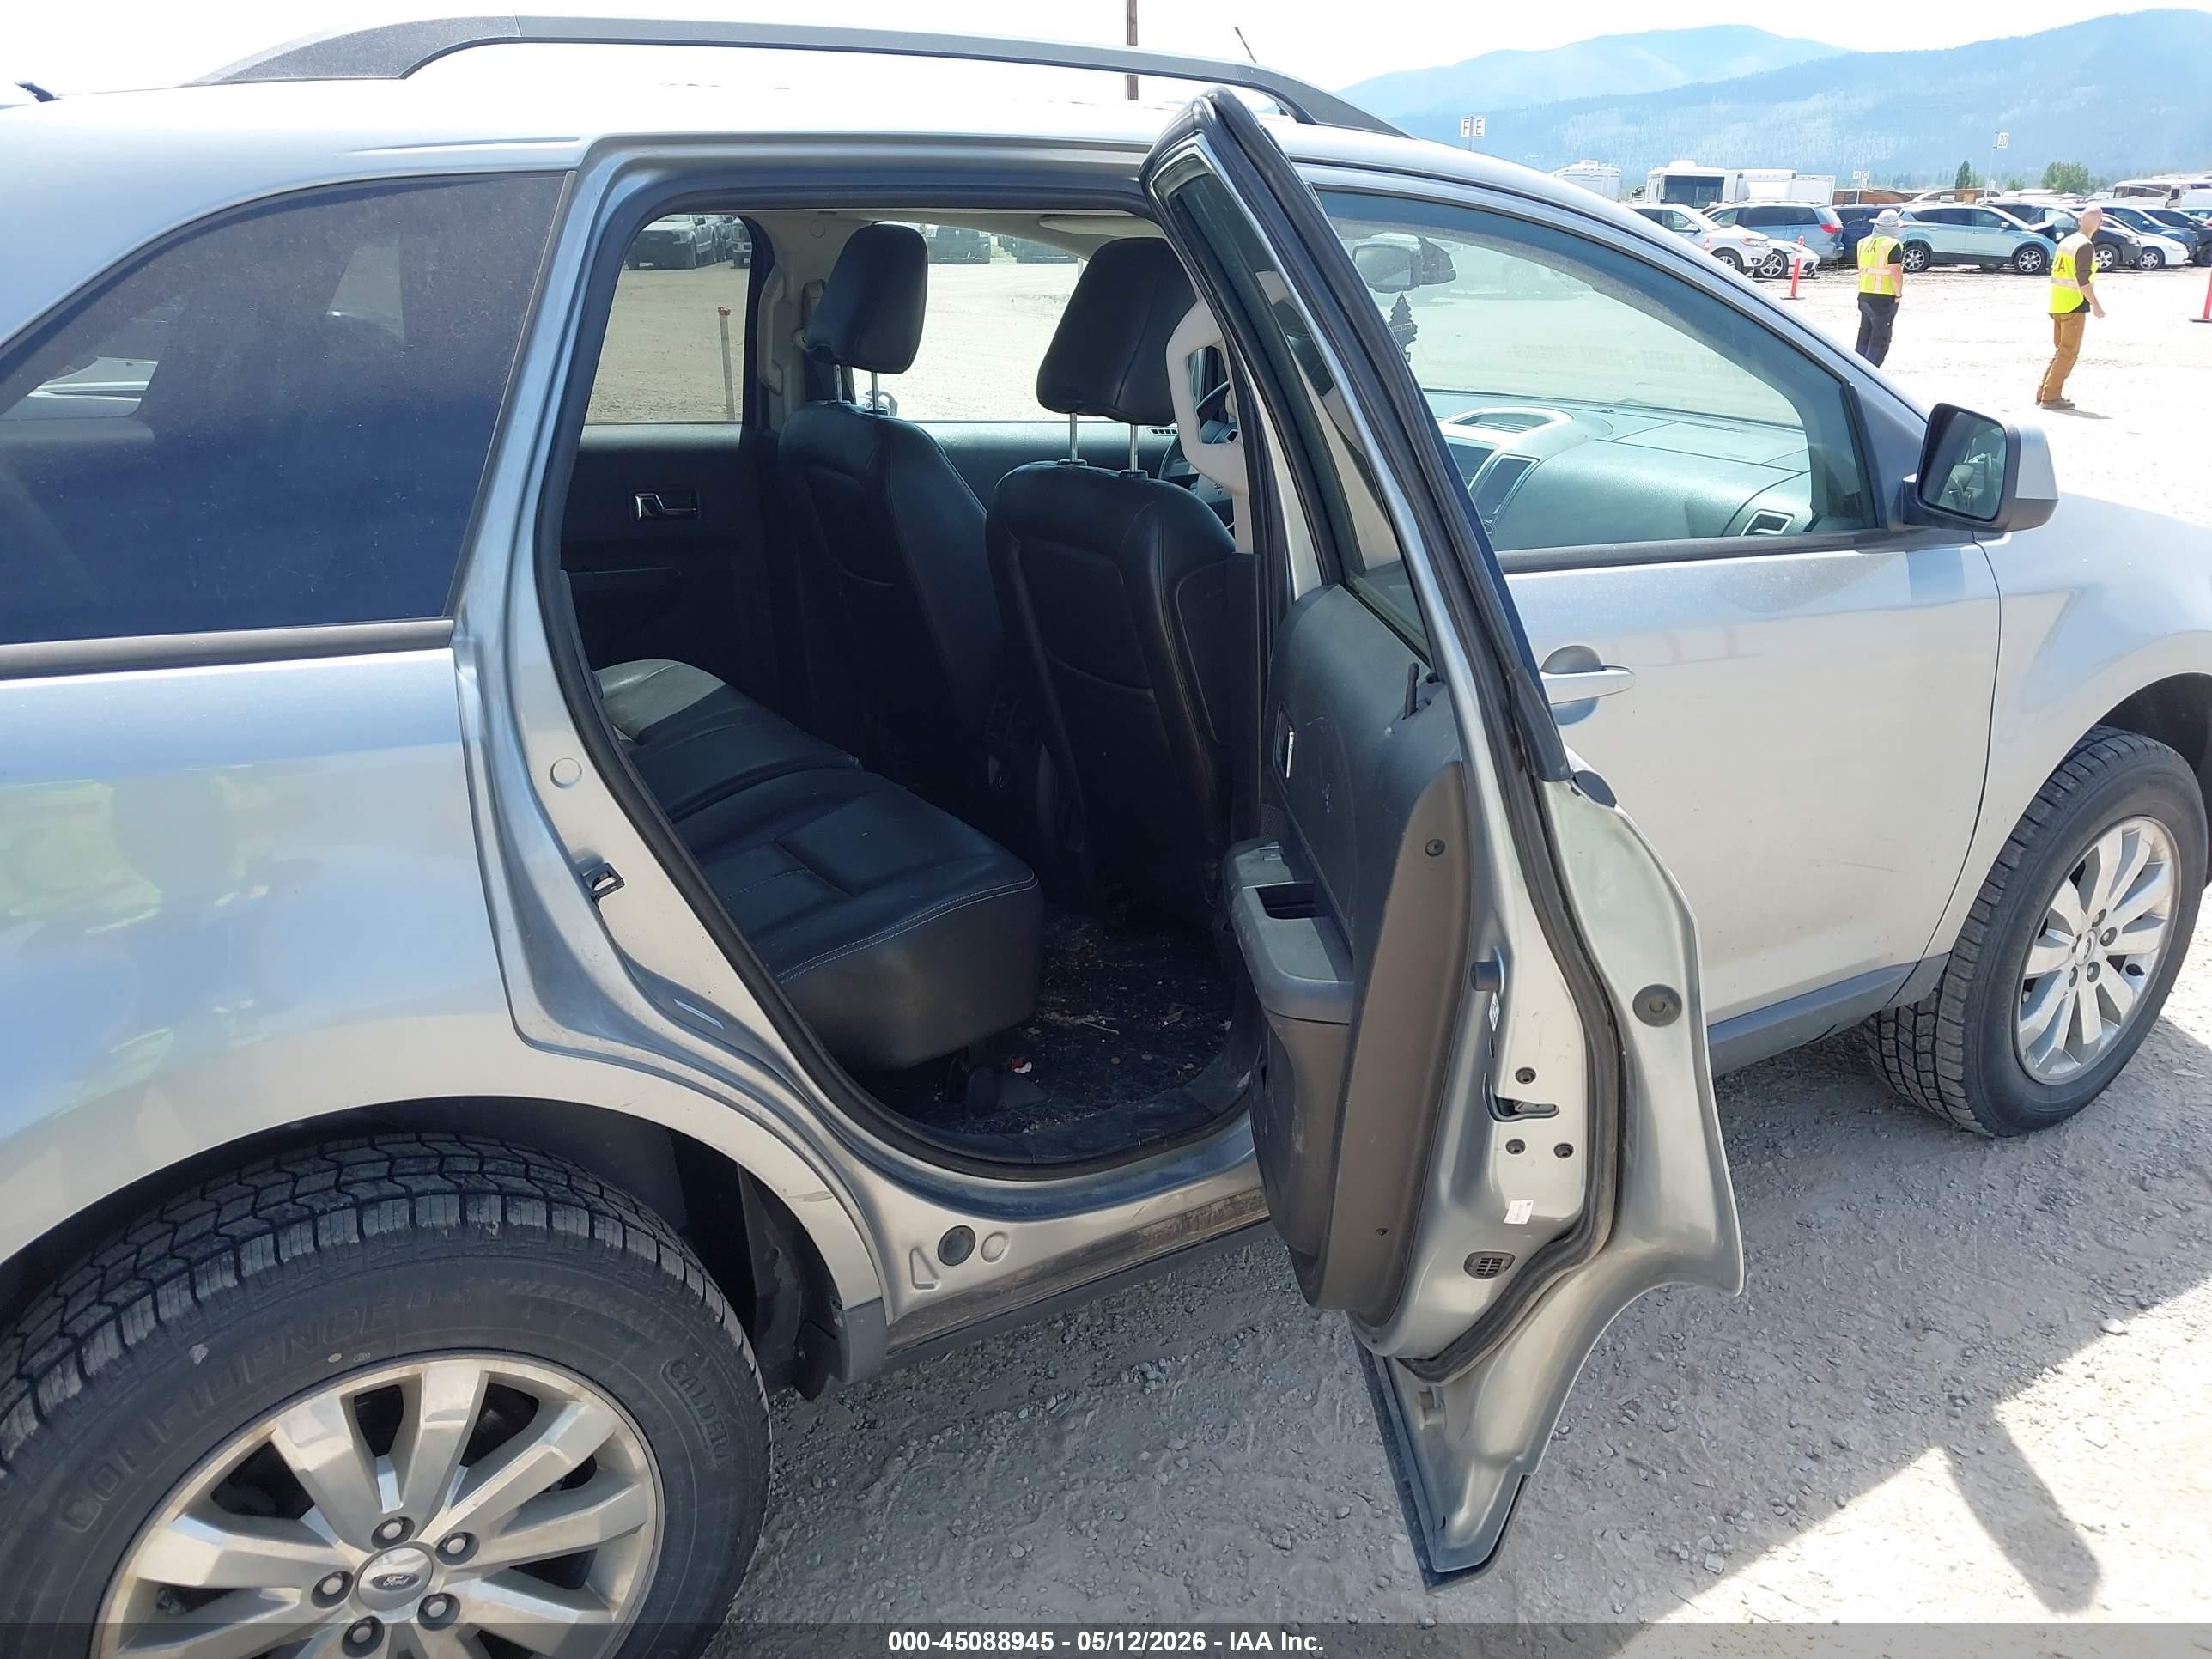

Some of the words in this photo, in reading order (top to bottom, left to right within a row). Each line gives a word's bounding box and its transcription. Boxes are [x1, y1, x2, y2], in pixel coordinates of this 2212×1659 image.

[1462, 120, 1469, 136] F
[1475, 119, 1482, 135] E
[382, 1575, 410, 1588] Ford
